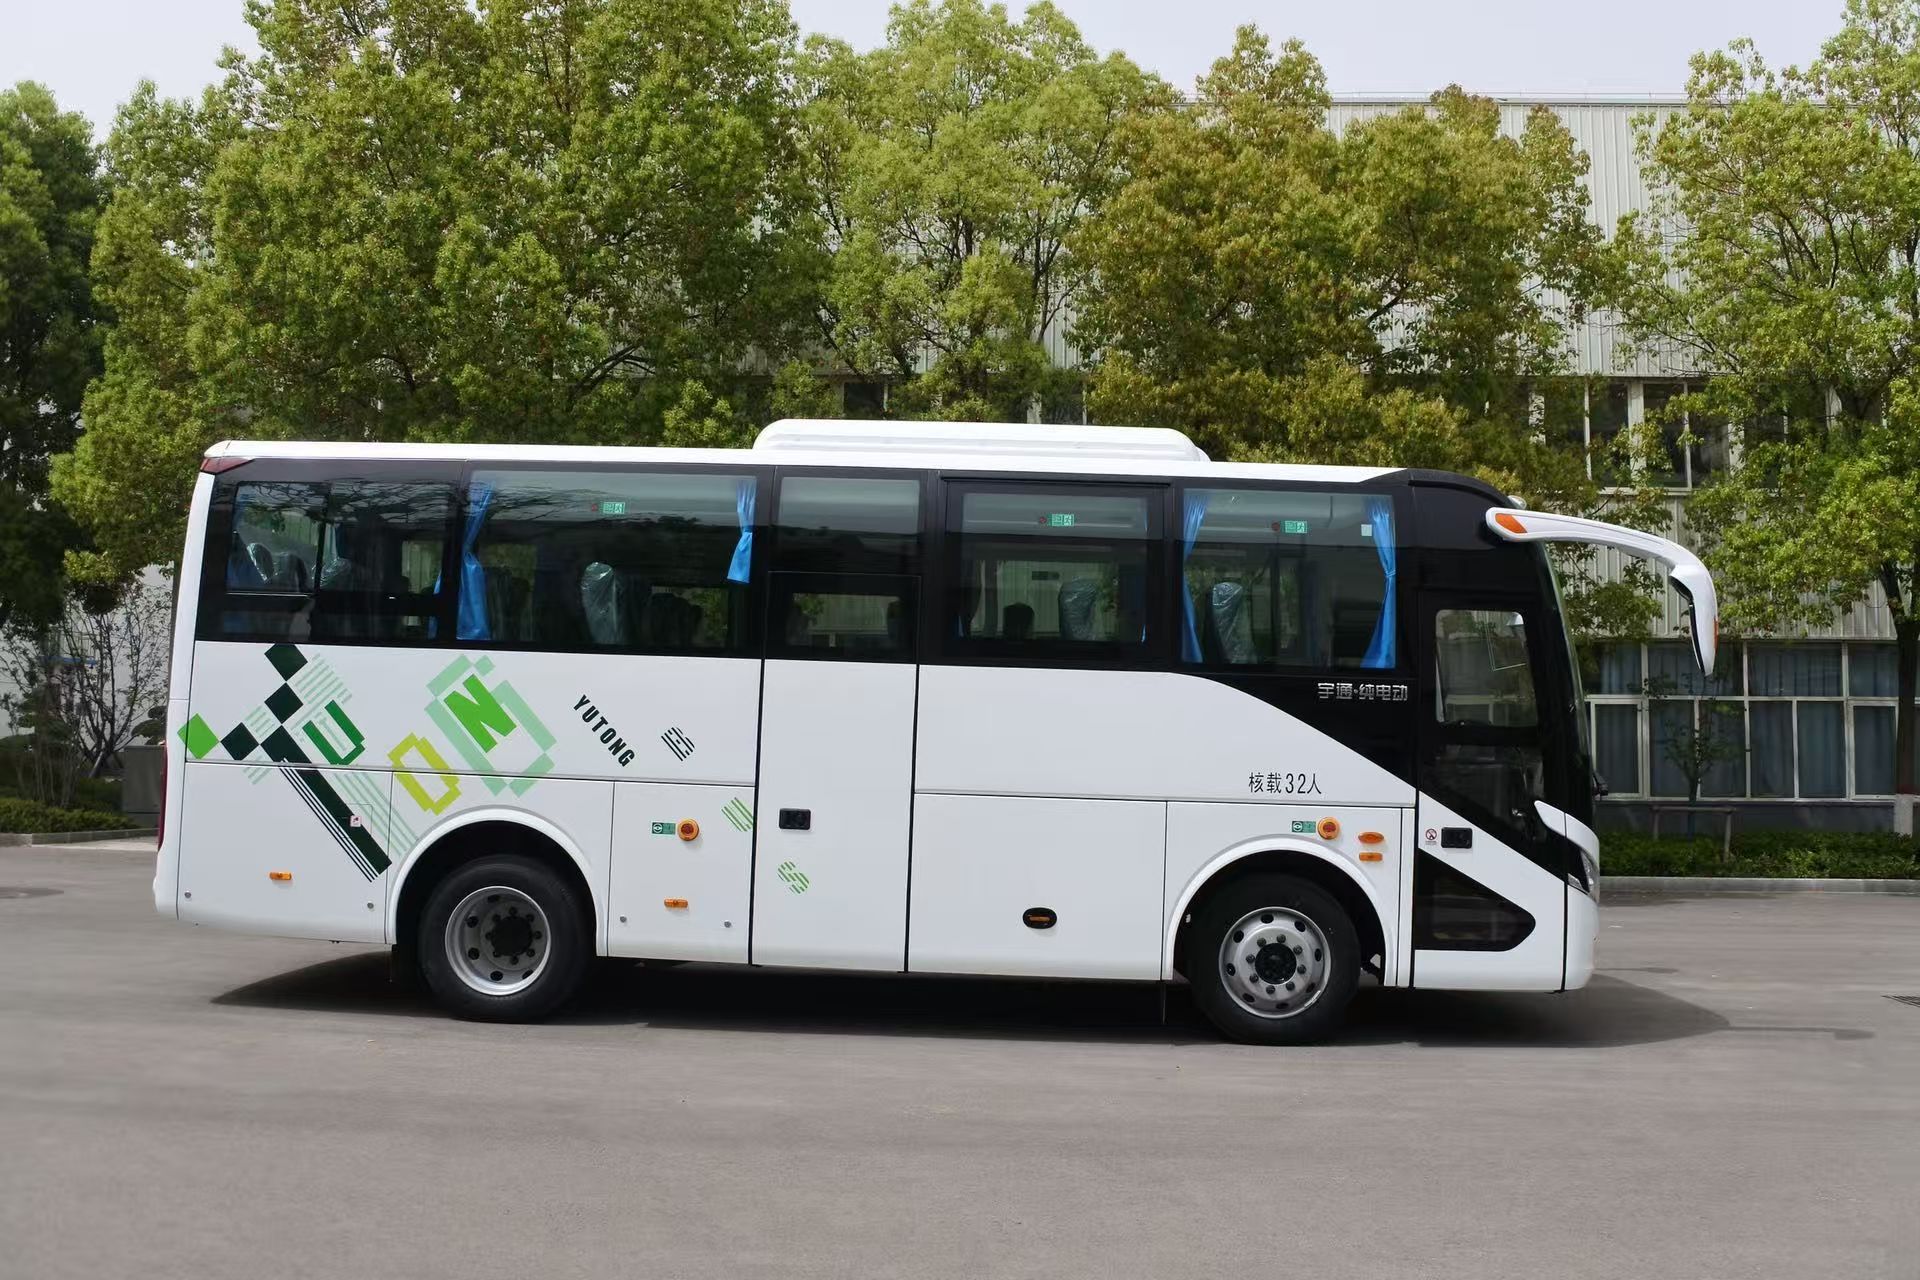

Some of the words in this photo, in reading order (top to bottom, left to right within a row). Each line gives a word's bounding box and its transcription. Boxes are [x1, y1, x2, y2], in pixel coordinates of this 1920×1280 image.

[573, 694, 635, 767] YUTONG
[1248, 771, 1322, 794] 核载32人
